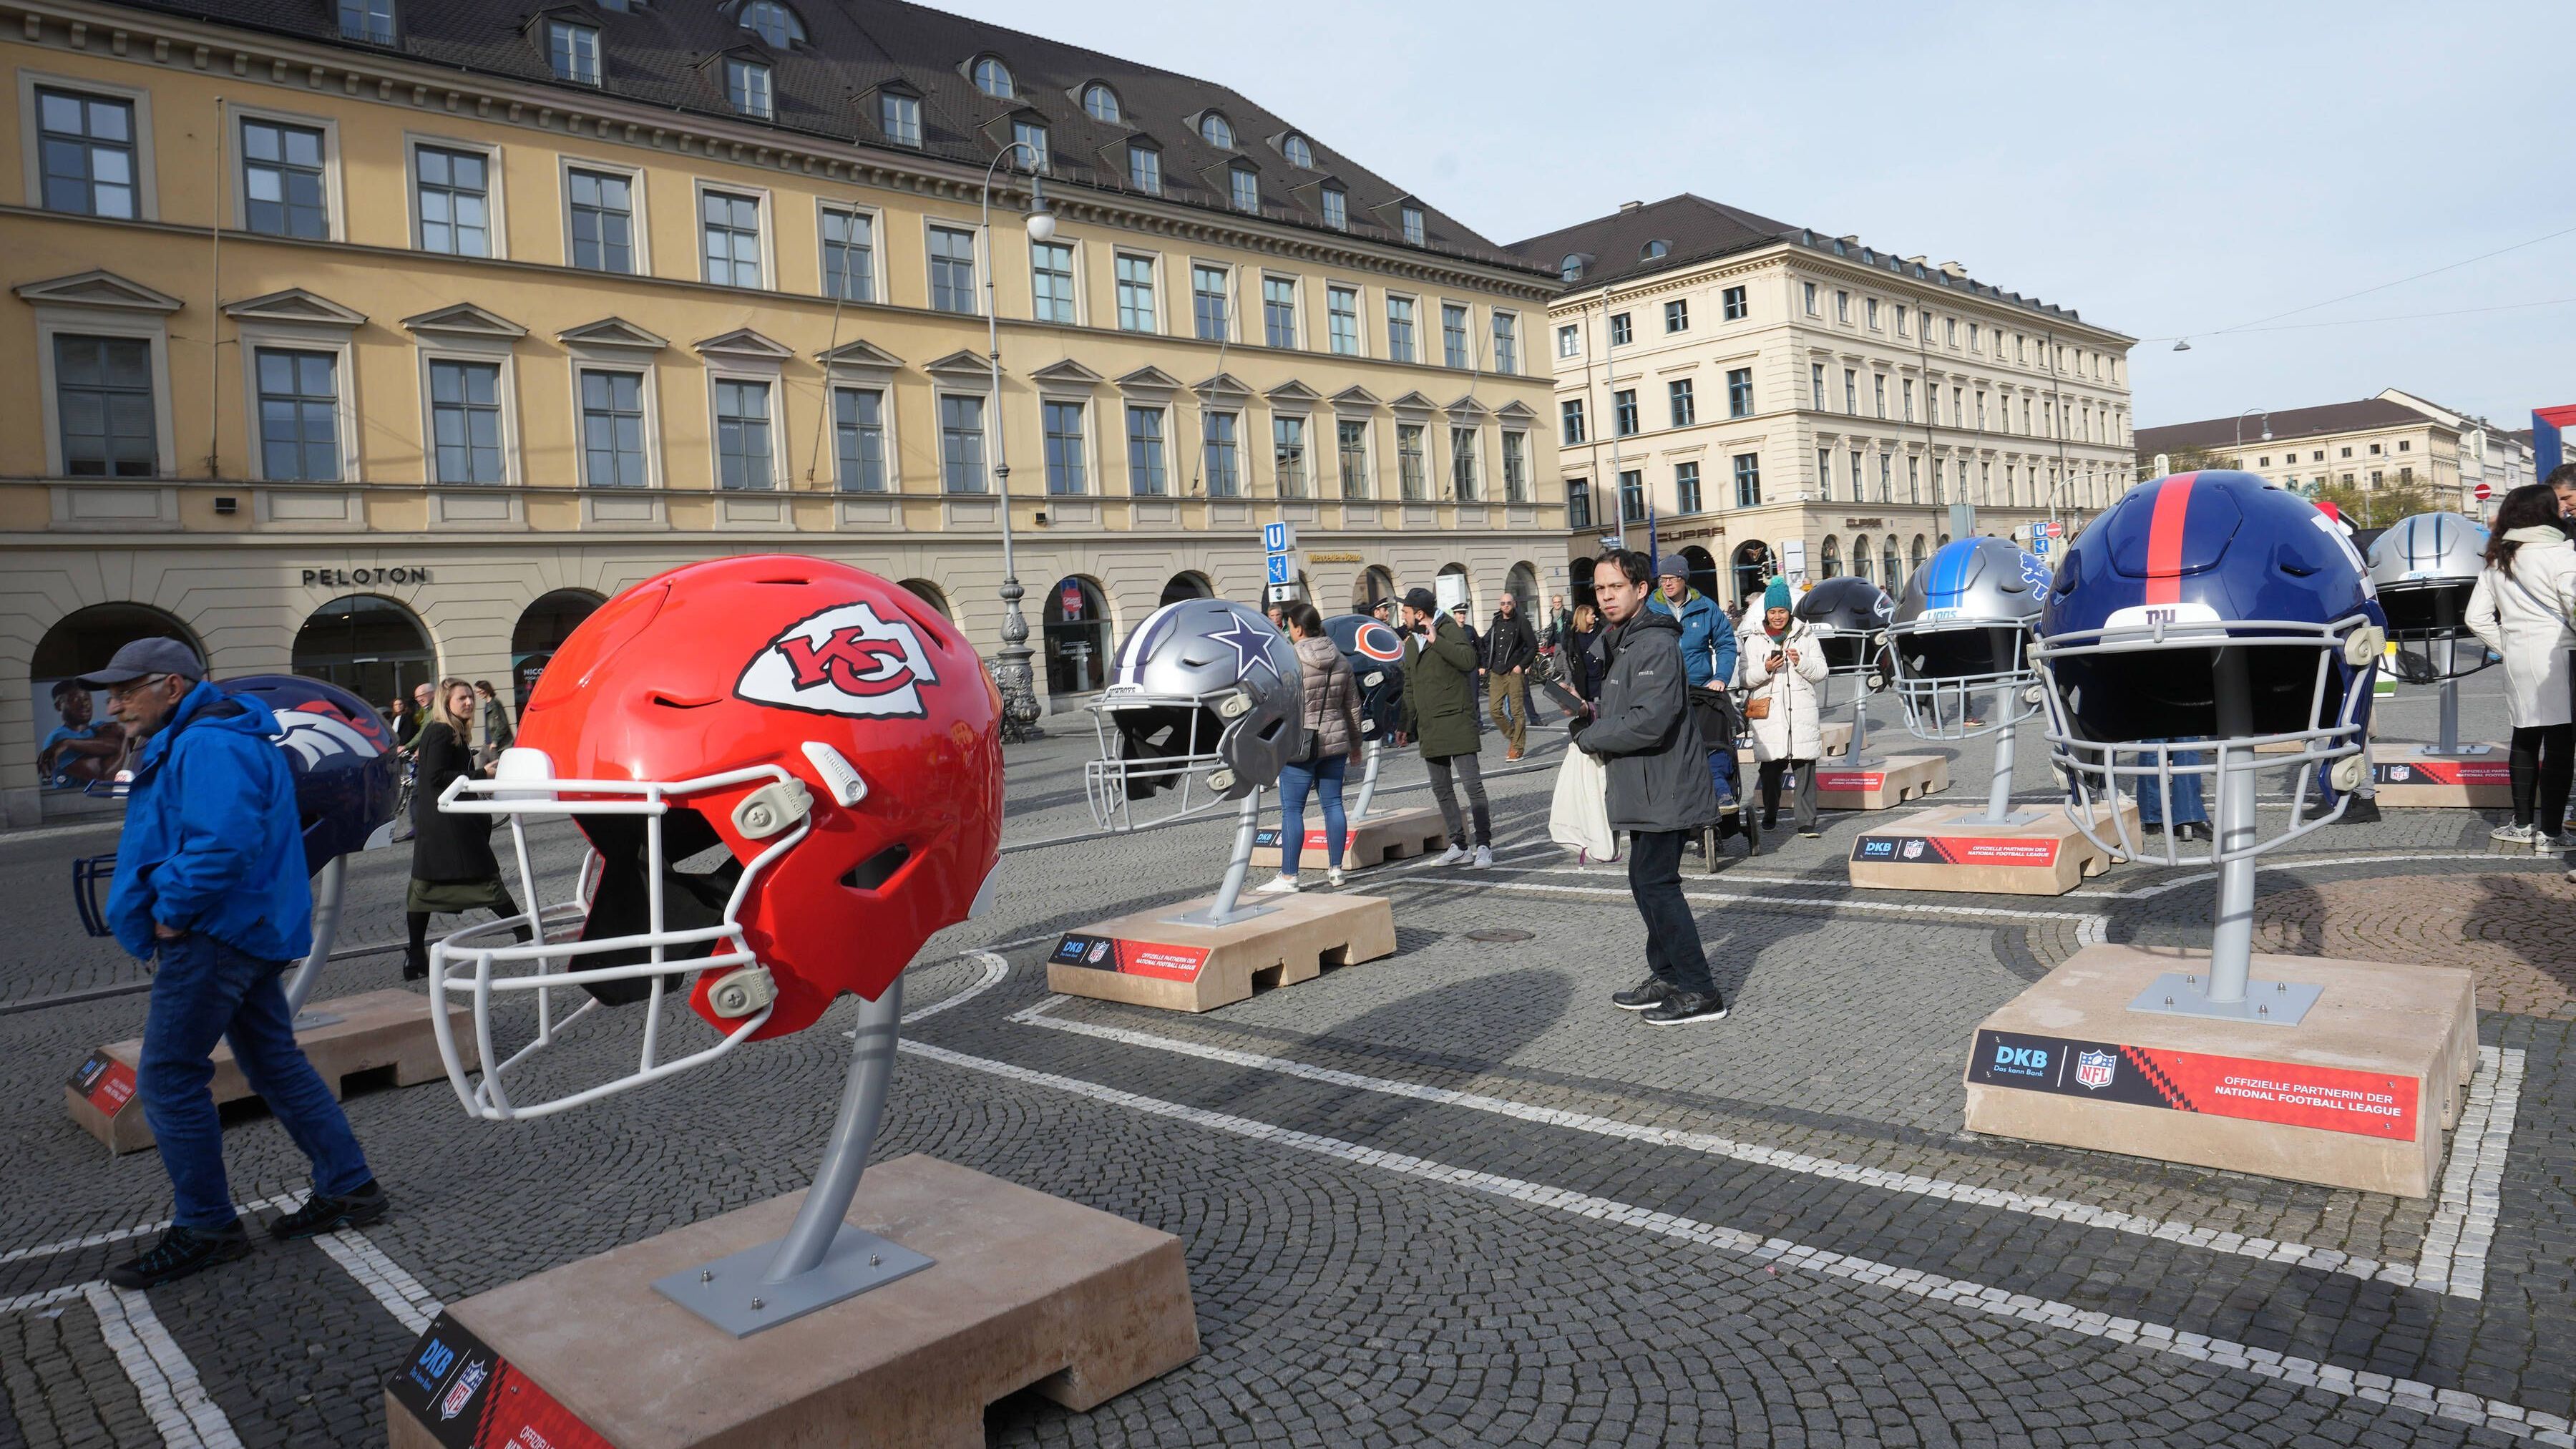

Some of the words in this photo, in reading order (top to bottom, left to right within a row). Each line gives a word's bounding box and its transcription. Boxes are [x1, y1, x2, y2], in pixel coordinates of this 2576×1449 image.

[1269, 527, 1282, 547] U
[1657, 527, 1726, 542] CUPRA
[2036, 525, 2046, 536] U
[302, 567, 426, 586] PELOTON
[774, 625, 916, 697] KC
[1865, 842, 1892, 852] DKB
[1063, 941, 1085, 953] DKB
[1996, 1045, 2048, 1068] DKB
[1994, 1065, 2008, 1073] Das
[2026, 1068, 2044, 1077] Bank
[2079, 1065, 2109, 1083] NFL
[2224, 1076, 2290, 1092] OFFIZIELLE
[2293, 1084, 2363, 1101] PARTNERIN
[2366, 1093, 2393, 1104] DER
[2215, 1085, 2275, 1101] NATIONAL
[2278, 1093, 2345, 1110] FOOTBALL
[2348, 1103, 2401, 1116] LEAGUE
[418, 1337, 455, 1379] DKB
[447, 1382, 469, 1412] NFL
